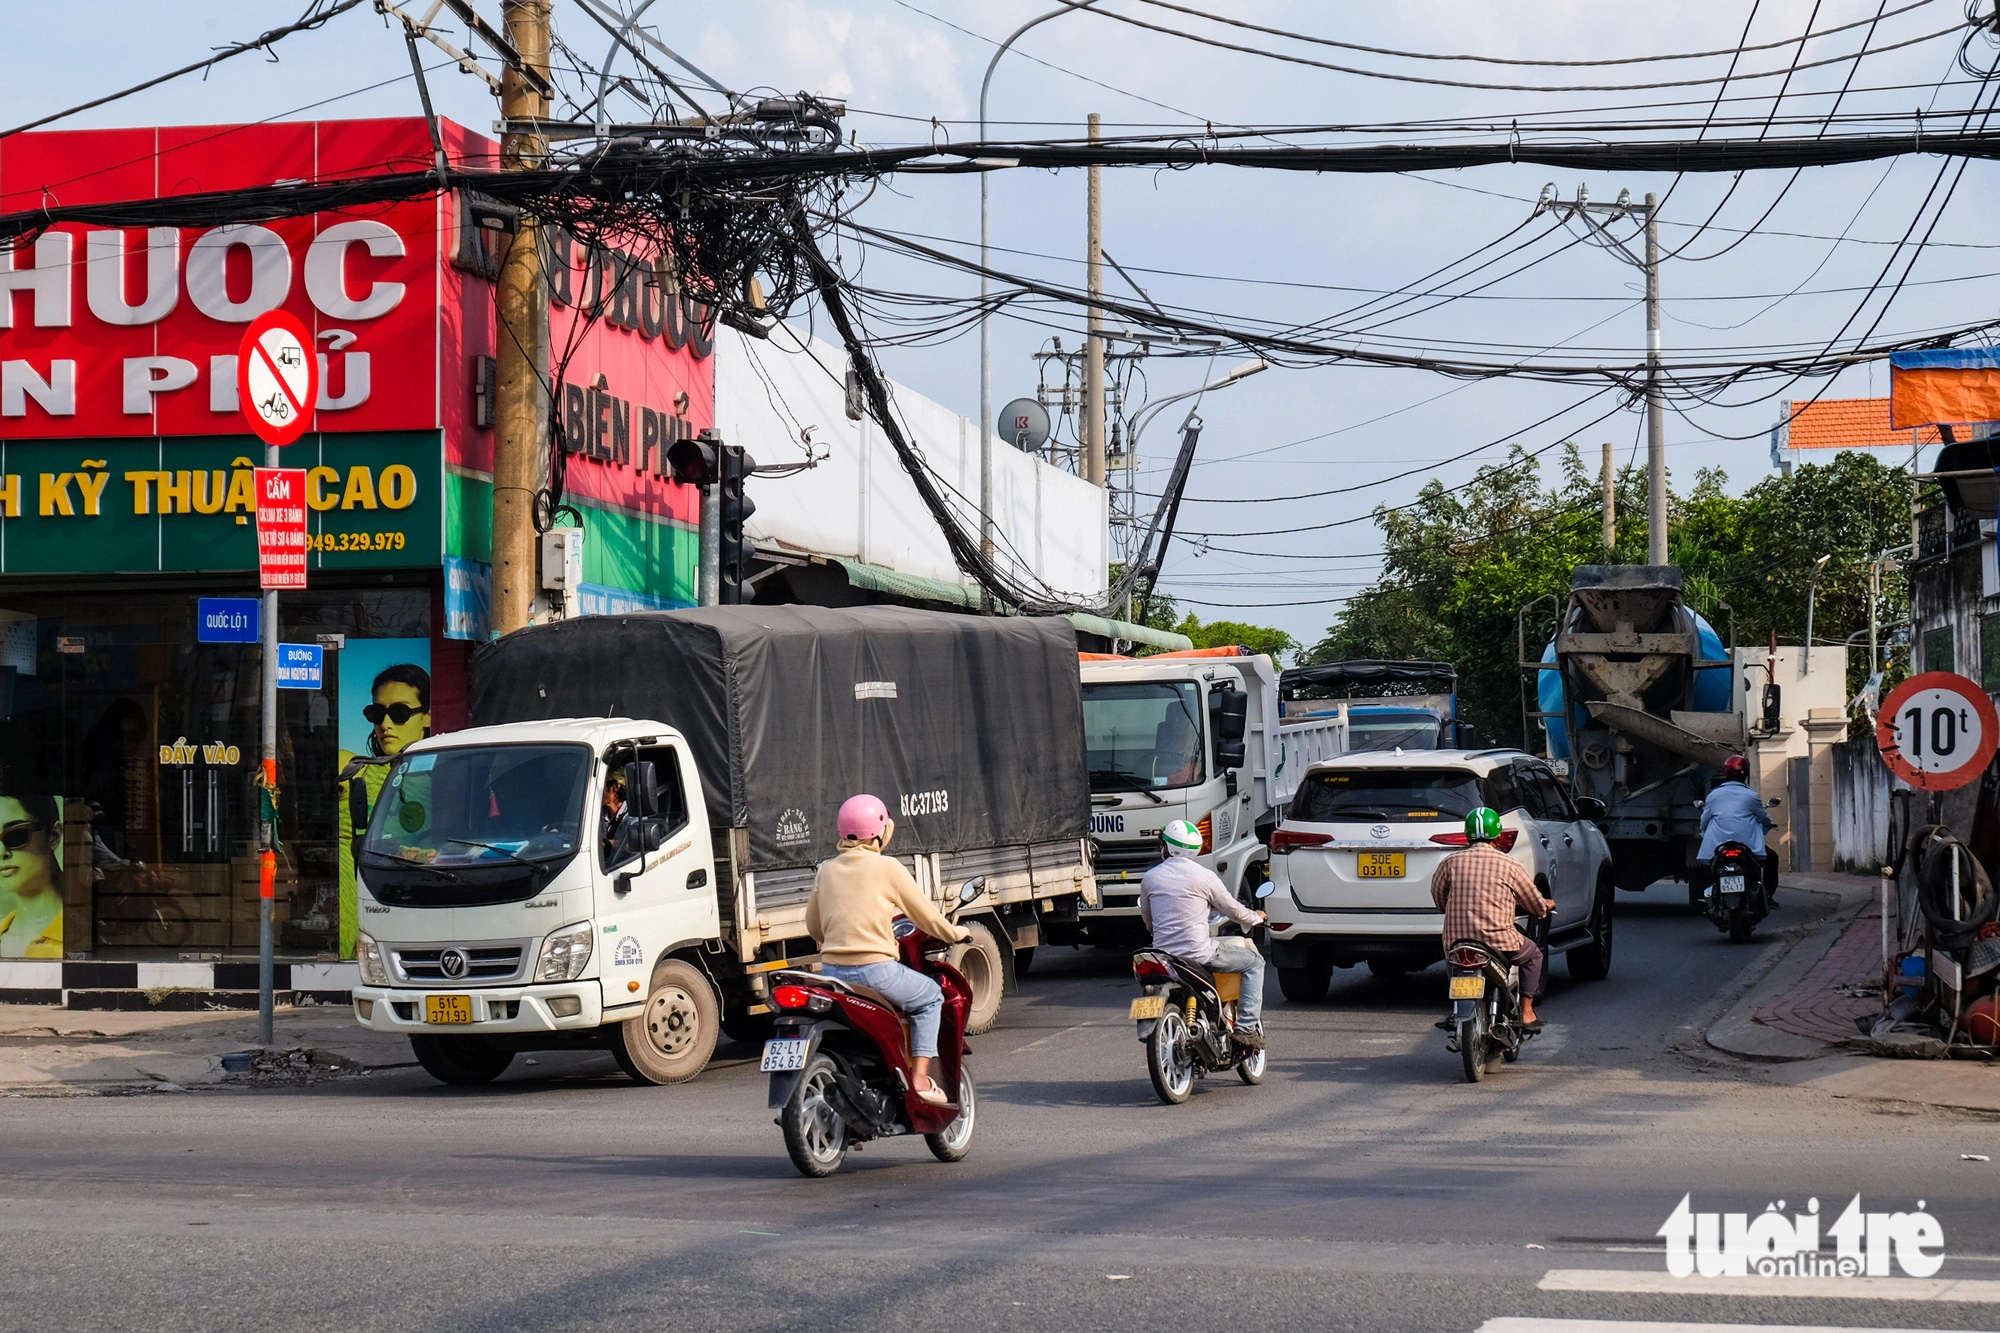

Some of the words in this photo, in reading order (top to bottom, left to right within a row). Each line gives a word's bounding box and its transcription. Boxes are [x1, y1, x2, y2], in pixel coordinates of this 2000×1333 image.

[563, 372, 629, 465] BIÊN
[39, 459, 110, 517] KỸ
[306, 464, 417, 511] CAO
[266, 472, 290, 499] CẤM
[289, 504, 302, 523] BÁNH
[207, 610, 229, 628] QUỐC
[231, 612, 241, 631] LỘ
[243, 615, 247, 628] 1
[288, 649, 312, 661] ĐƯỜNG
[159, 736, 198, 764] ĐẨY
[202, 741, 240, 765] VÀO
[1371, 854, 1391, 865] 50E
[1363, 866, 1400, 876] 031.16
[438, 997, 459, 1009] 61C
[432, 1010, 467, 1022] 371.93
[770, 1041, 800, 1054] 62-L1
[764, 1055, 802, 1069] 854.62
